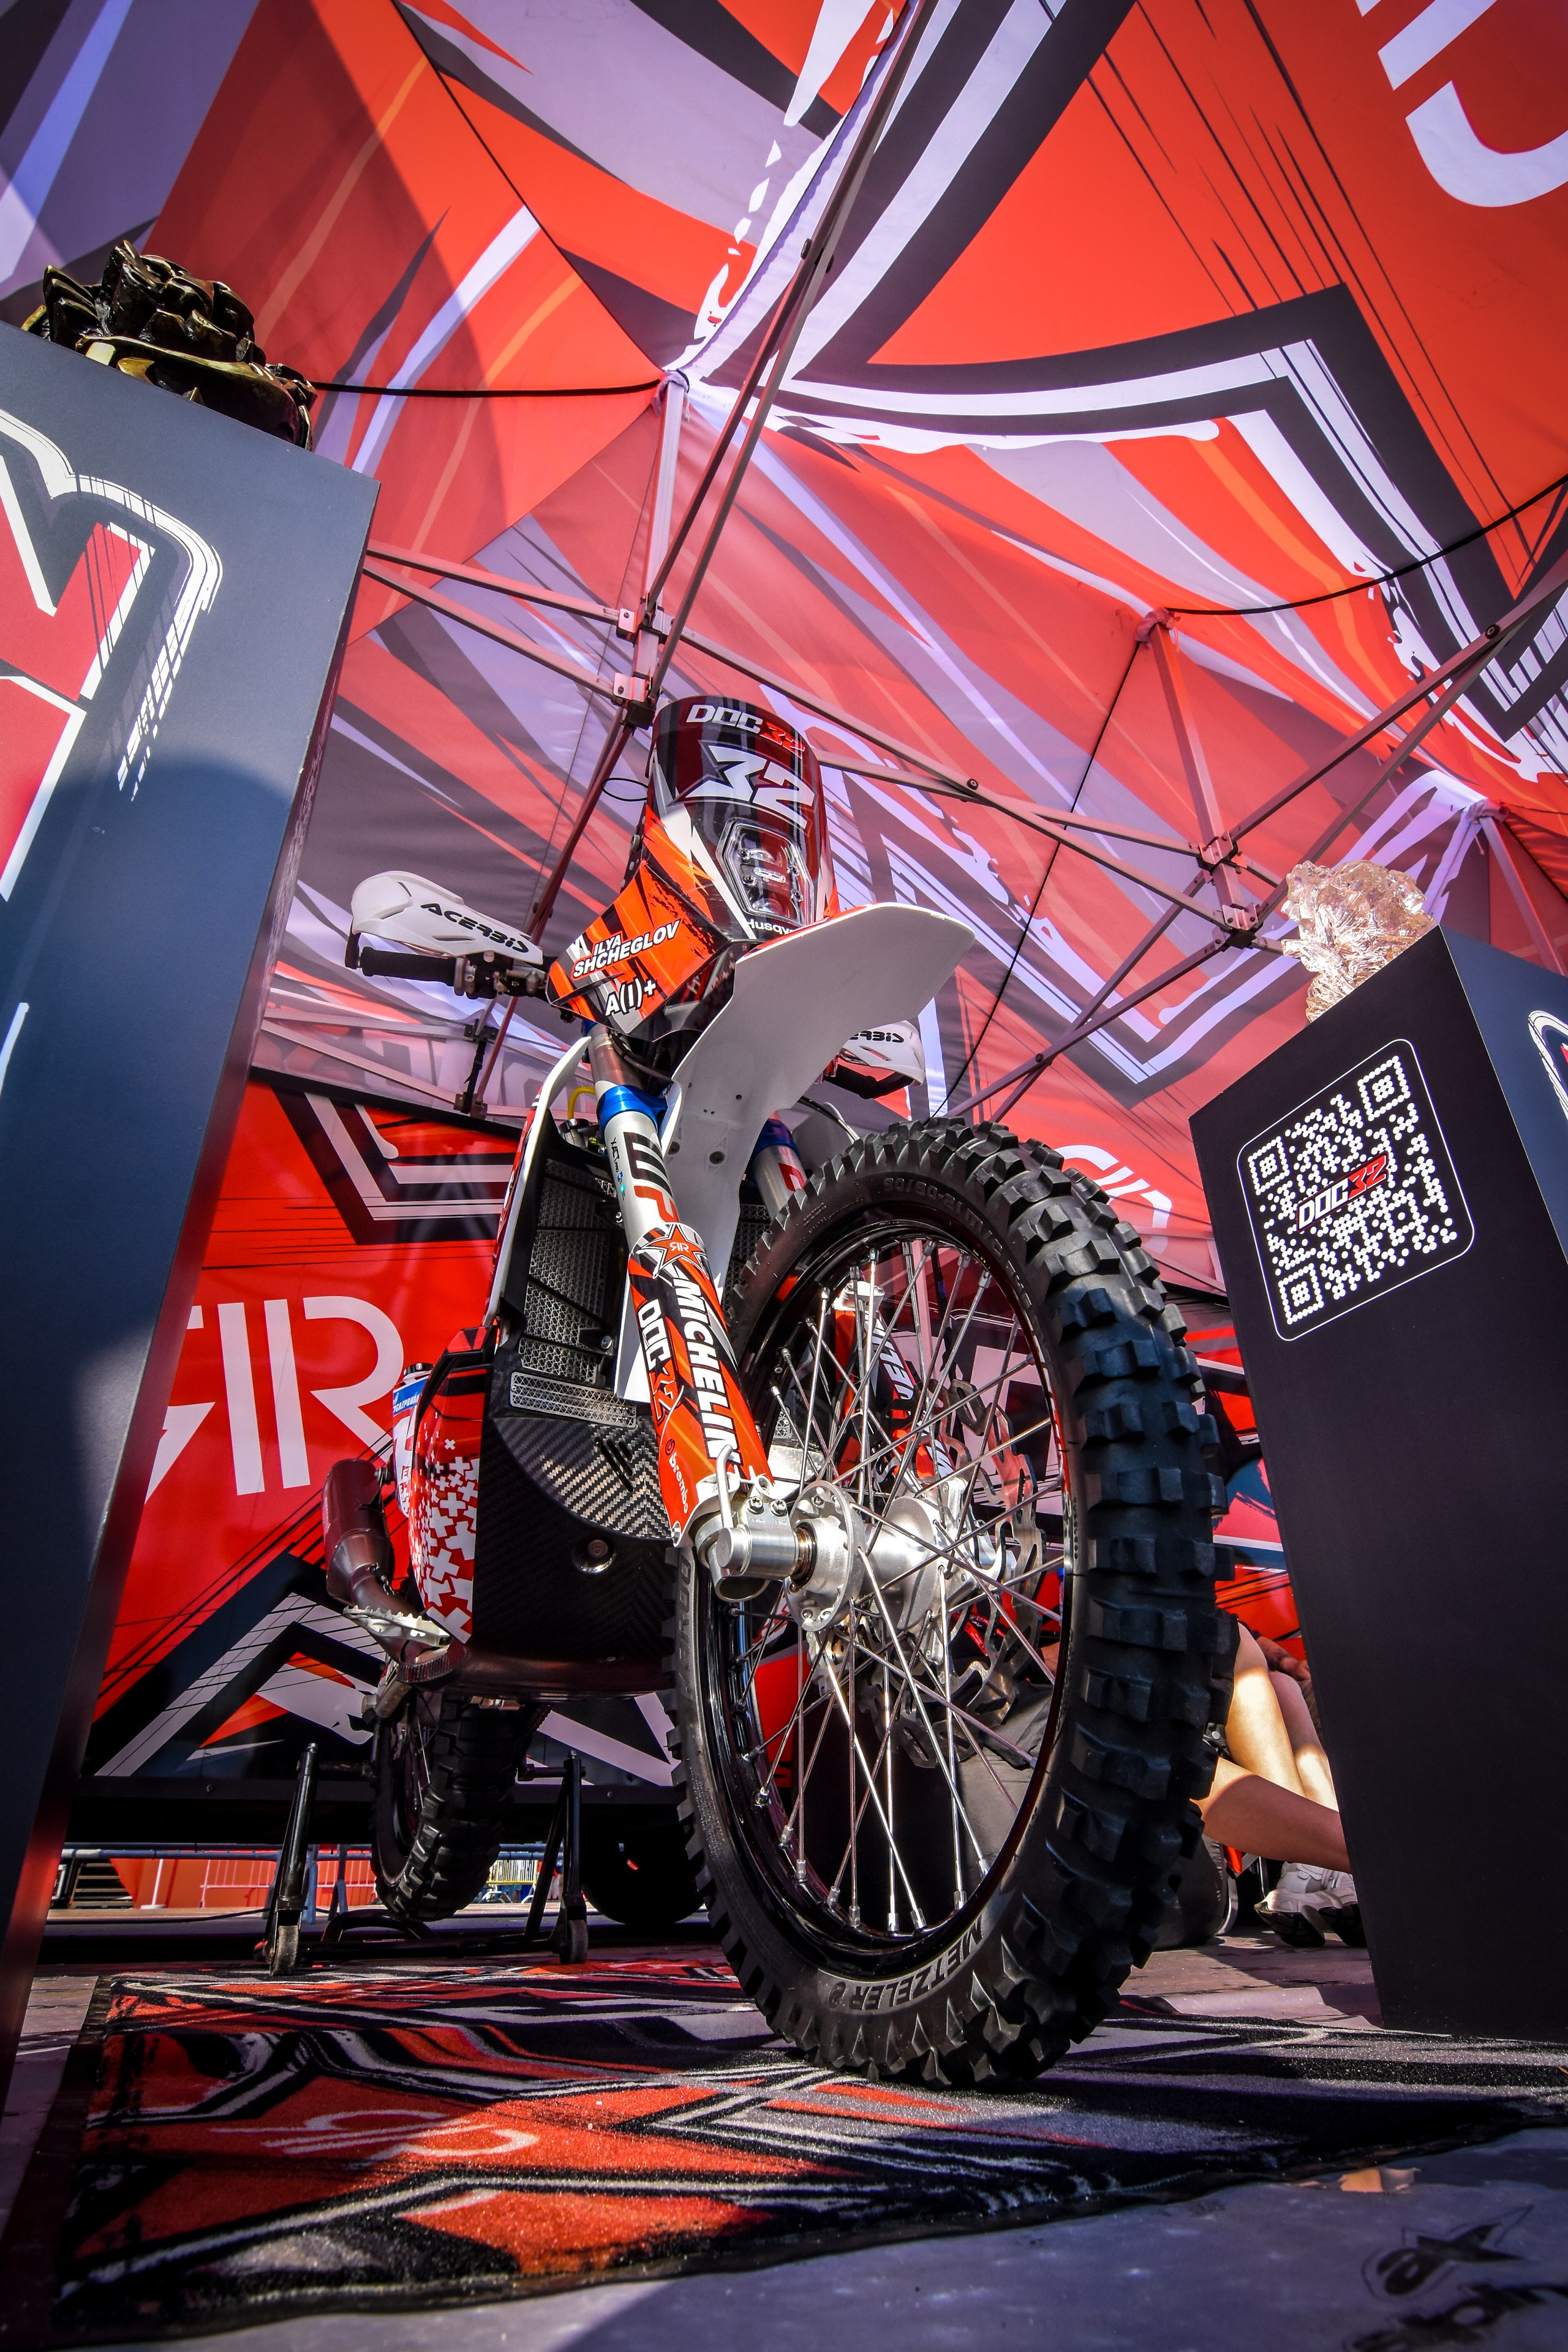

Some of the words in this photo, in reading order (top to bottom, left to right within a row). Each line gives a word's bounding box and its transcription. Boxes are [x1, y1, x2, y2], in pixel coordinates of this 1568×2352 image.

[685, 704, 806, 760] DOC32
[684, 744, 816, 830] 32
[573, 919, 680, 978] SHCHEGLOV
[593, 934, 622, 956] ILYA
[1298, 1155, 1387, 1229] DOC32
[638, 1298, 680, 1421] DOC32
[673, 1277, 742, 1465] MICHELIN
[668, 1452, 688, 1514] brembo
